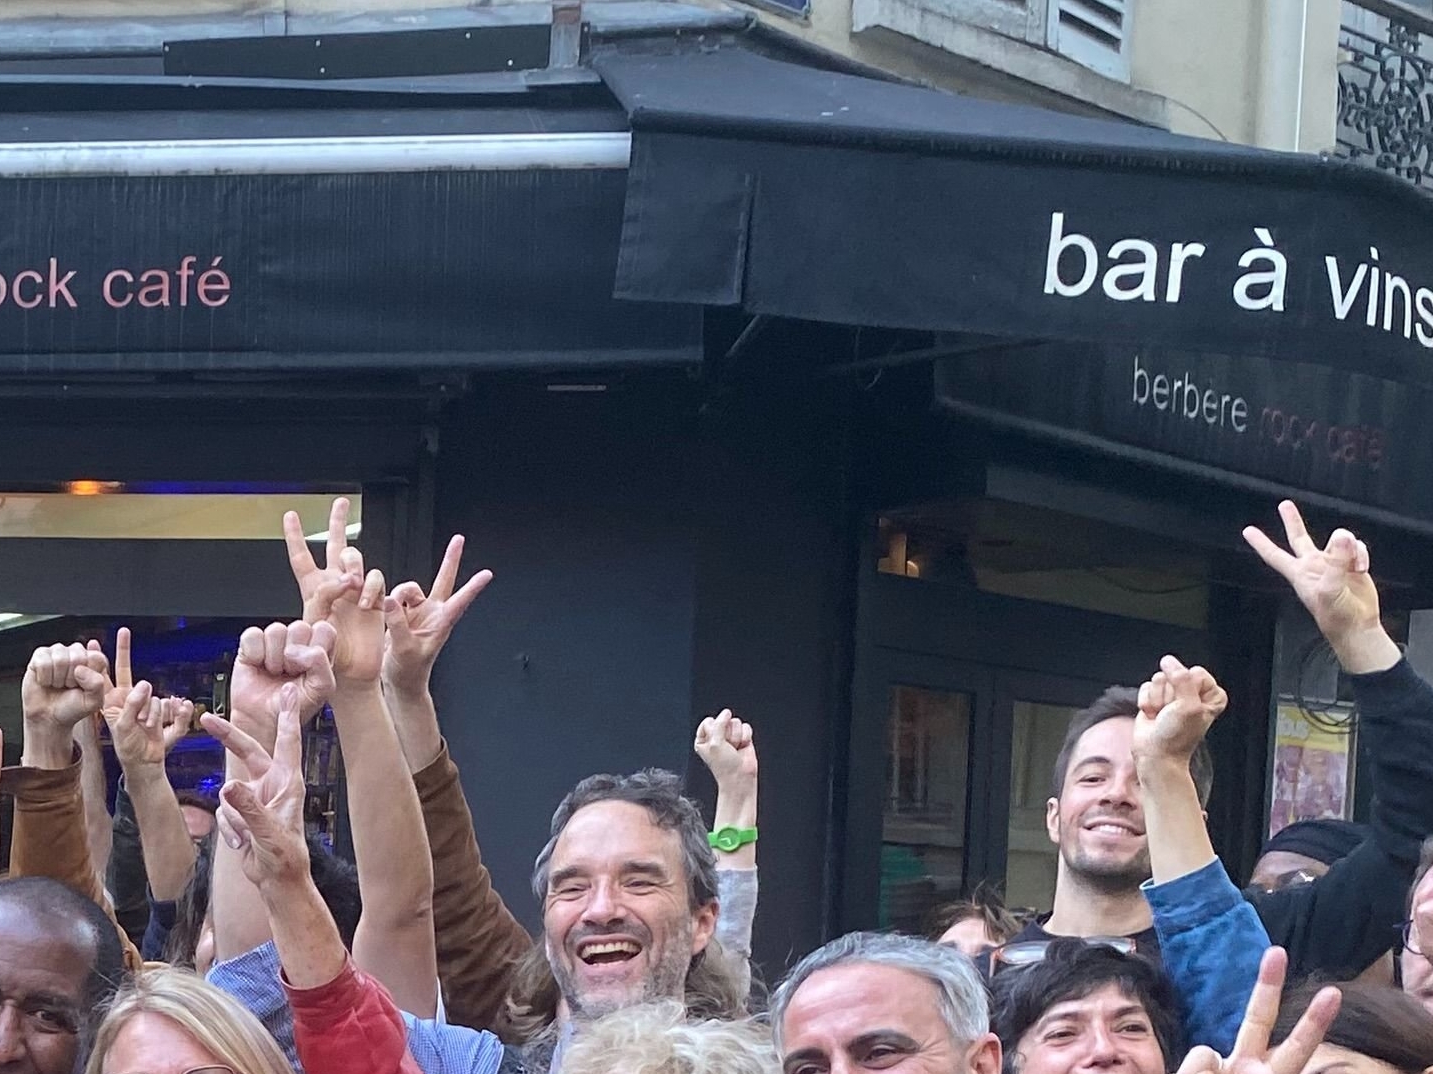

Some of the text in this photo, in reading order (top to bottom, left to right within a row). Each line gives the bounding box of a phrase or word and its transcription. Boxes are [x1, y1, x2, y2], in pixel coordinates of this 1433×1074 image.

[103, 256, 231, 307] café
[1043, 212, 1433, 348] bar à vins
